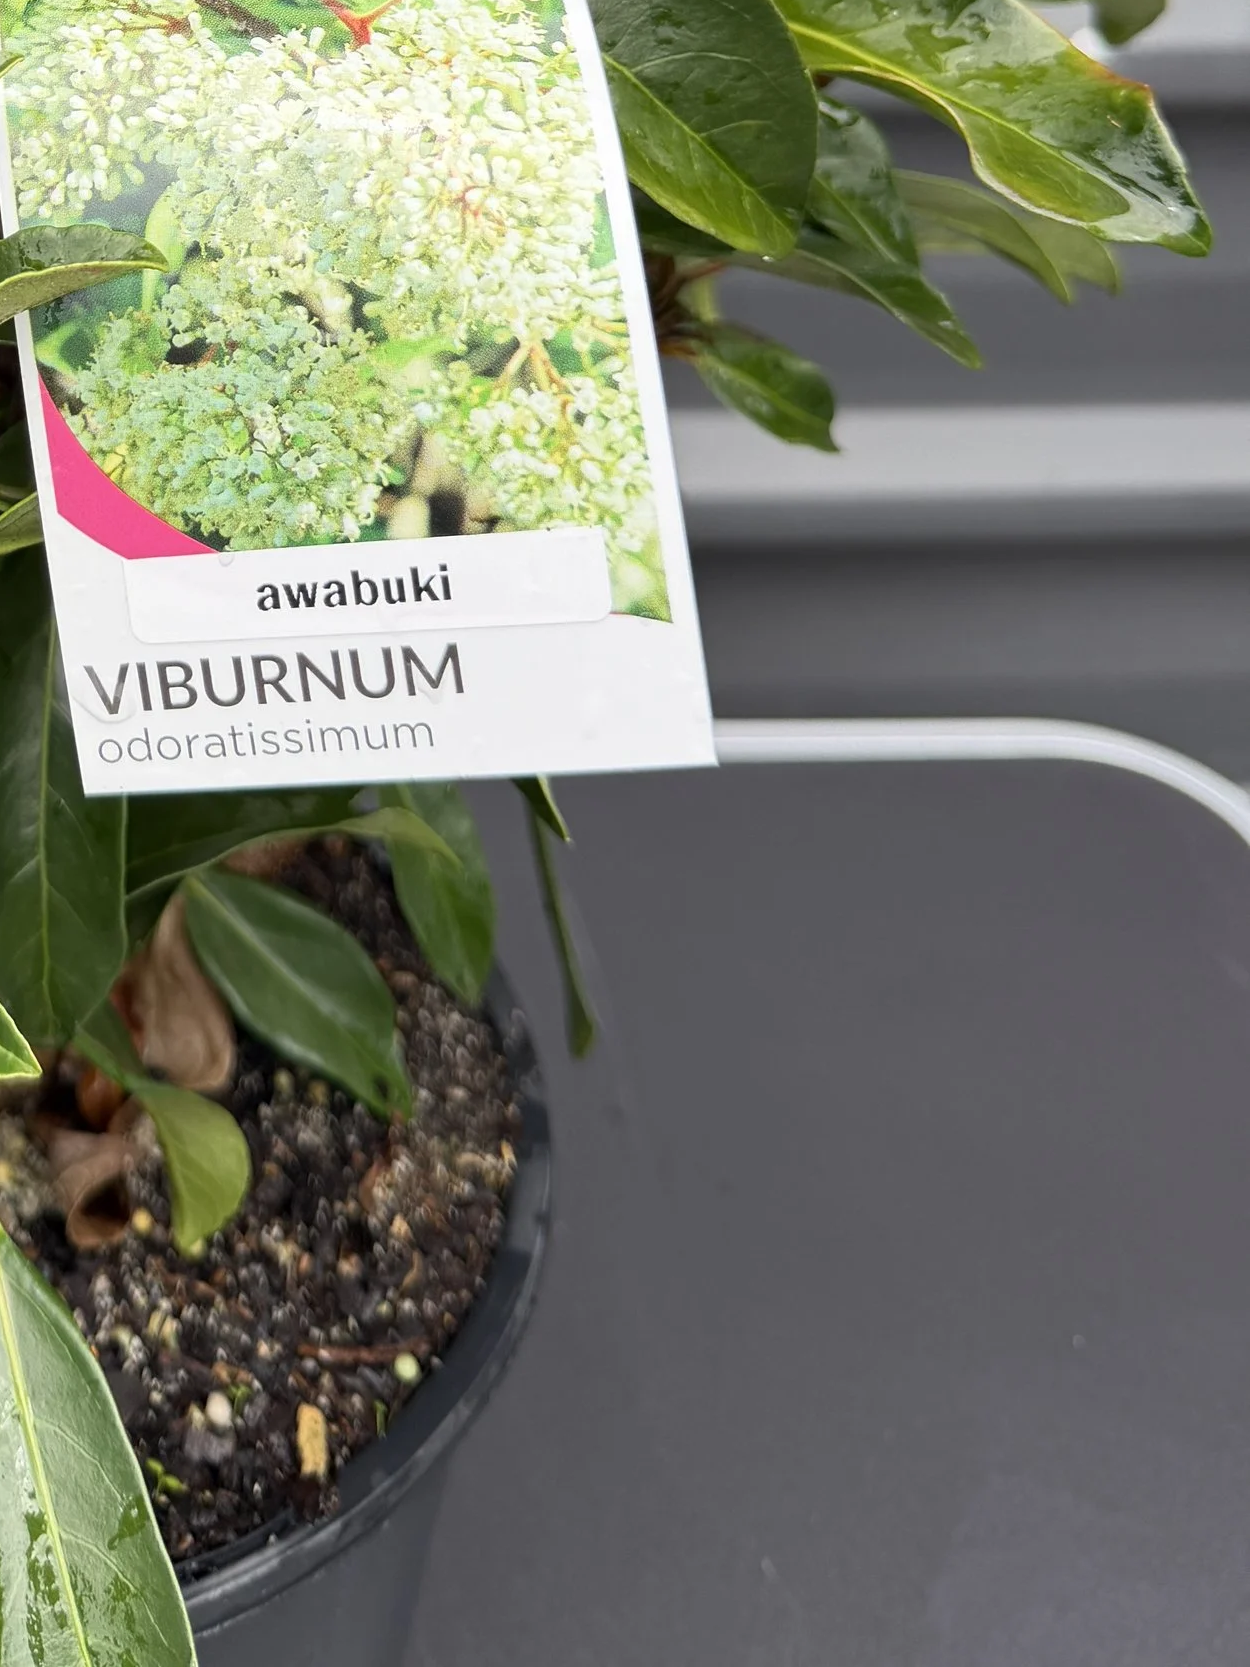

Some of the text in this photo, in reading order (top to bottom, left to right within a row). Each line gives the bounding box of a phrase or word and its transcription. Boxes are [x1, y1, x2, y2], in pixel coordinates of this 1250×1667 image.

[256, 562, 453, 612] awabuki
[83, 641, 466, 716] VIBURNUM
[96, 718, 435, 764] odoratissimum
